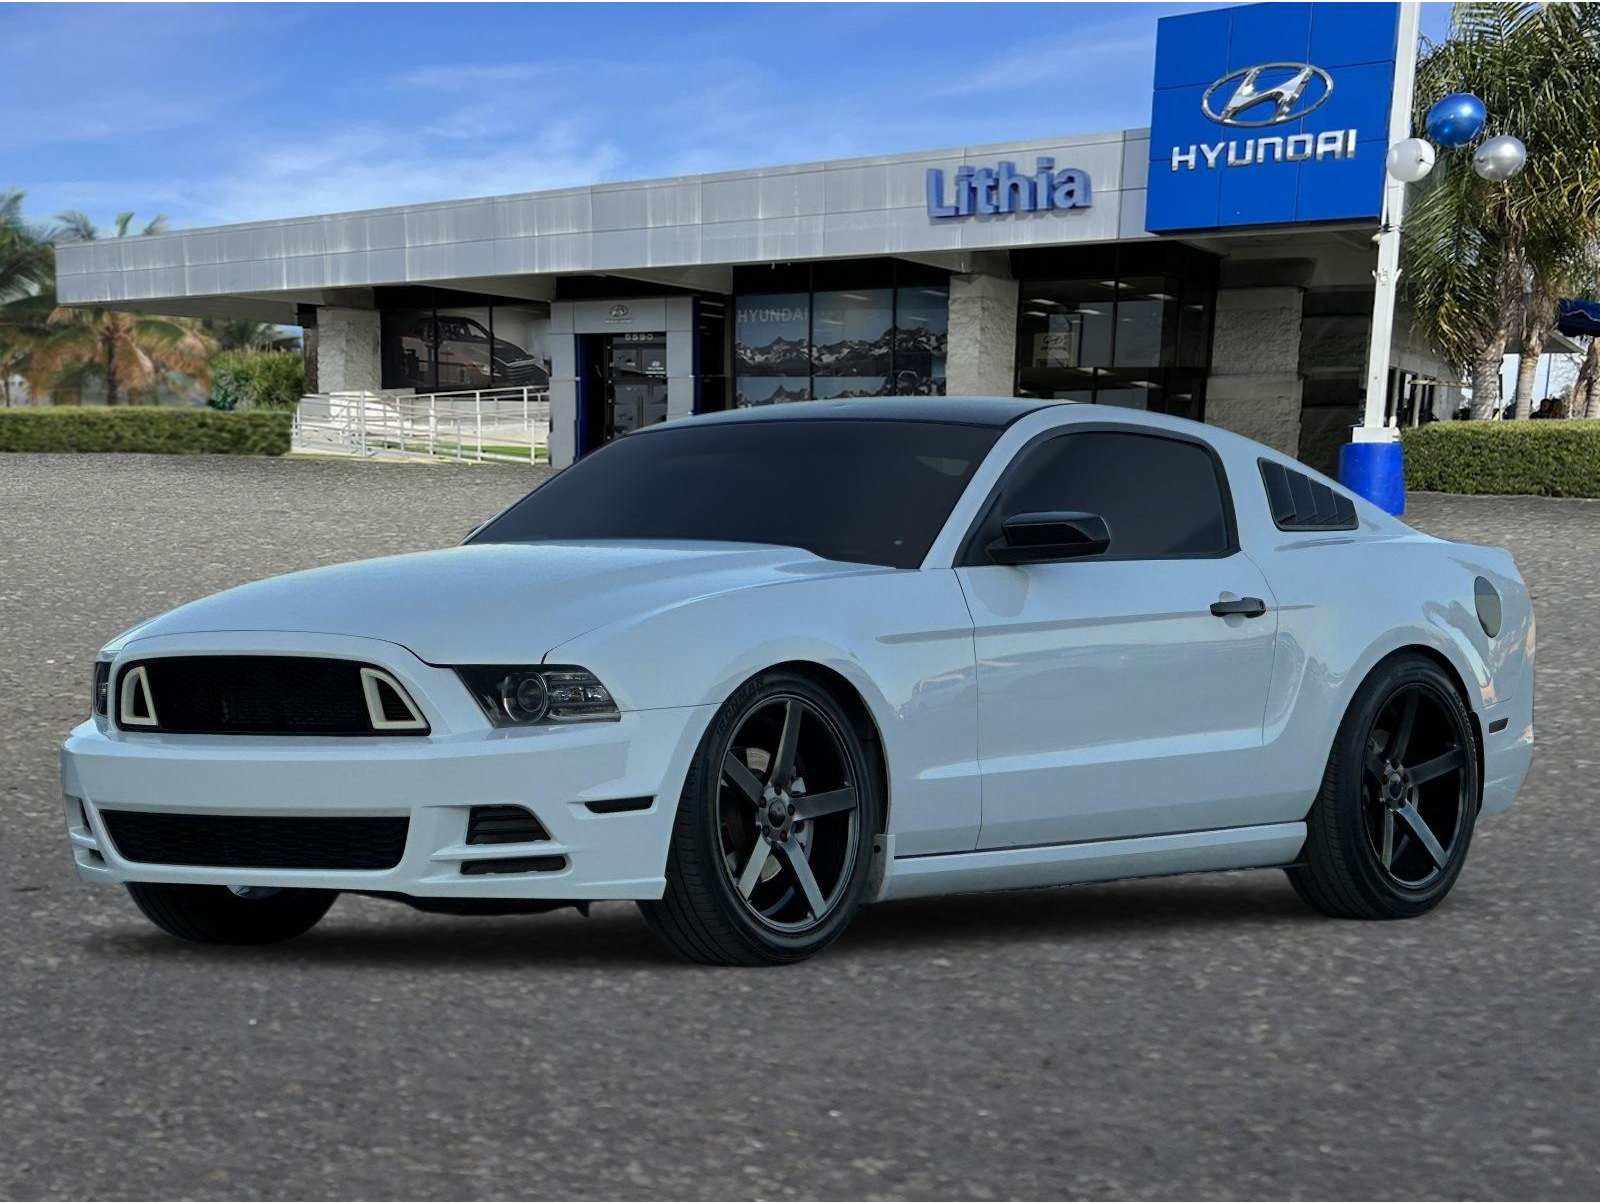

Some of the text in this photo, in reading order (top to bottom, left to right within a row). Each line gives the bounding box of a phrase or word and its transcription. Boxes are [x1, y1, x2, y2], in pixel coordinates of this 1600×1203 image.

[1171, 128, 1357, 172] HYUNDAI
[926, 157, 1093, 219] Lithia
[737, 307, 809, 323] HYUNDAI
